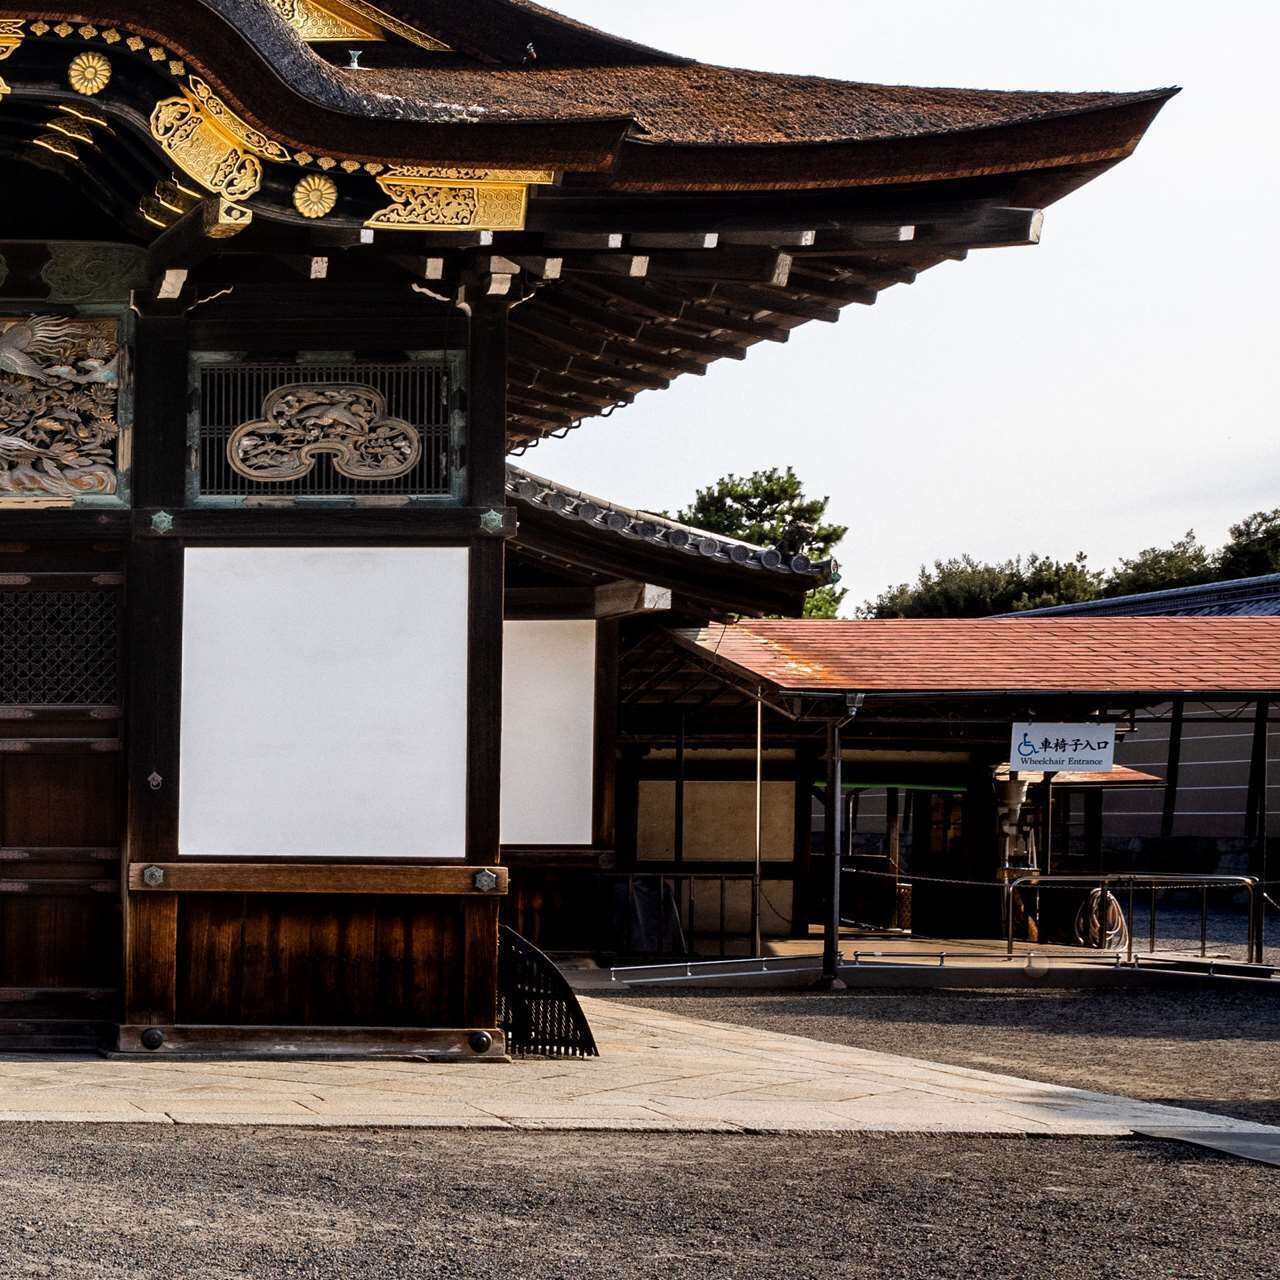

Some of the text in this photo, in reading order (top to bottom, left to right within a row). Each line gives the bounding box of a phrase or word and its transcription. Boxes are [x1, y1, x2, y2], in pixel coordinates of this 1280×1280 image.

[1039, 737, 1109, 753] 車椅子入口
[1020, 757, 1104, 766] Wheelchair Entrance
